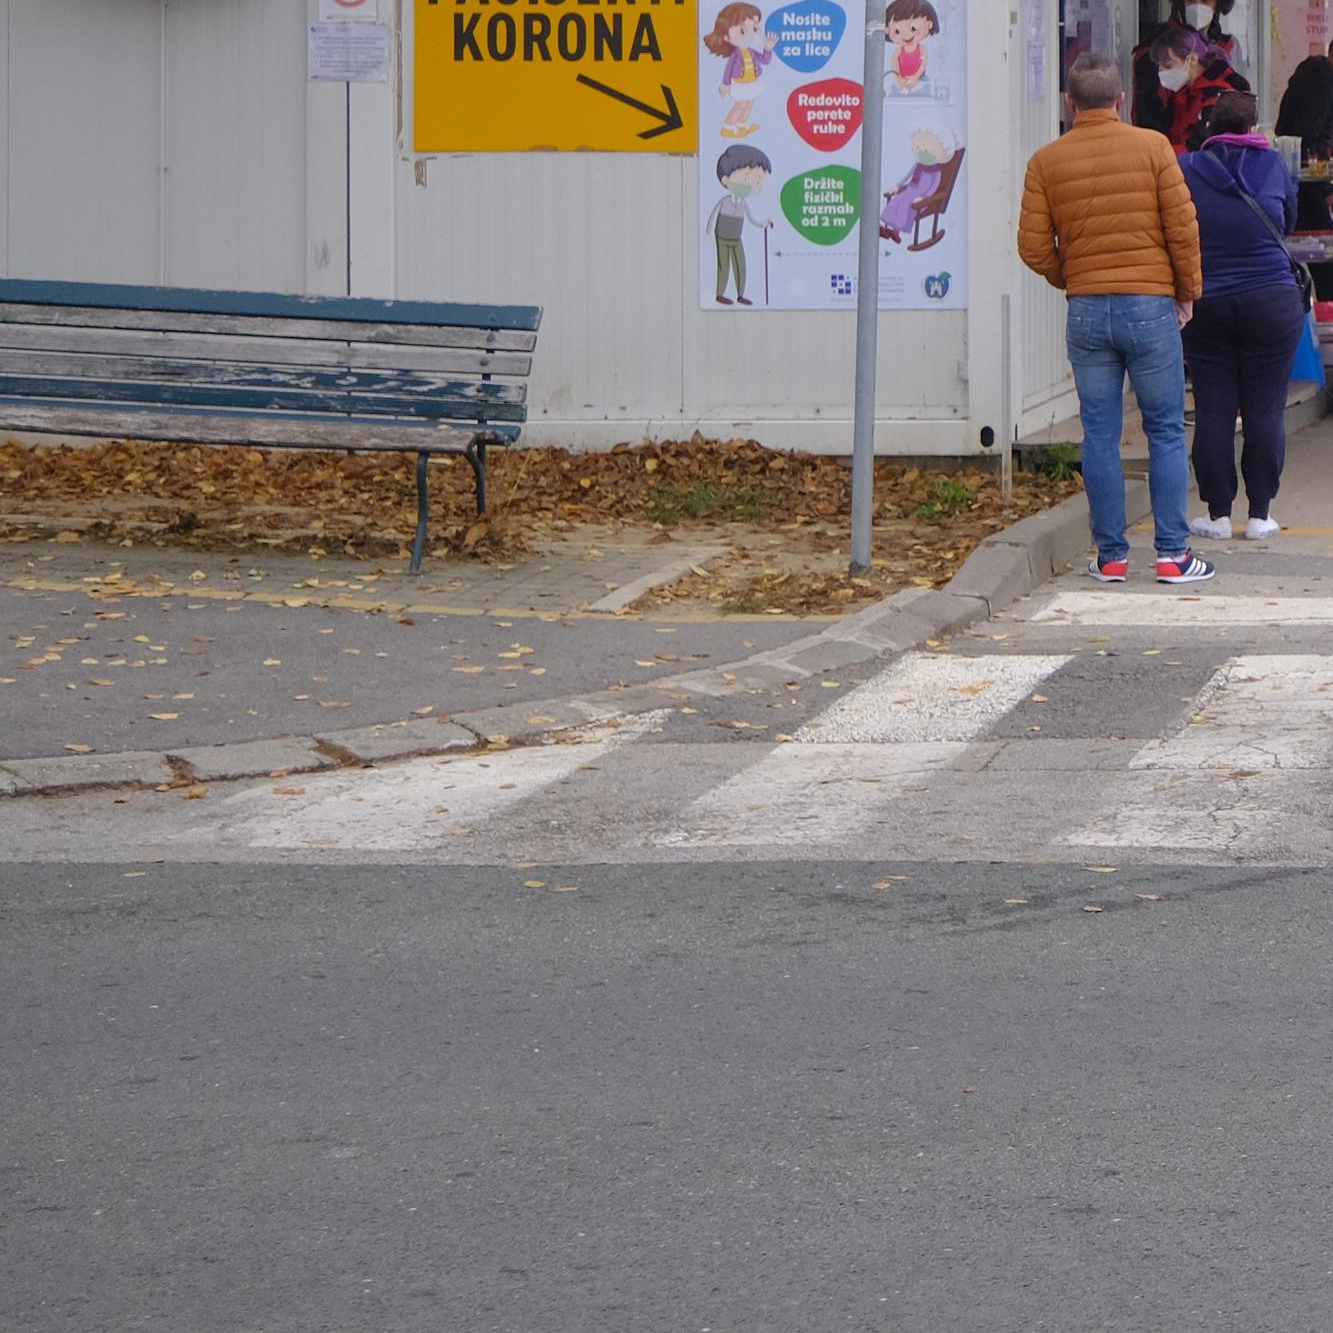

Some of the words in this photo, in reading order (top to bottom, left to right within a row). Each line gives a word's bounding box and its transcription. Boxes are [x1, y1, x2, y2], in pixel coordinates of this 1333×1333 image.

[783, 13, 830, 26] Nosite
[453, 12, 662, 61] KORONA
[781, 28, 832, 42] masku
[783, 46, 801, 56] za
[805, 43, 830, 56] lice
[798, 93, 860, 106] Redovito
[807, 108, 851, 122] perete
[812, 121, 845, 134] ruke
[803, 177, 844, 190] Držite
[803, 190, 844, 203] fizički
[802, 203, 854, 215] razmak
[802, 215, 819, 227] od
[821, 215, 830, 227] 2
[833, 218, 846, 227] m
